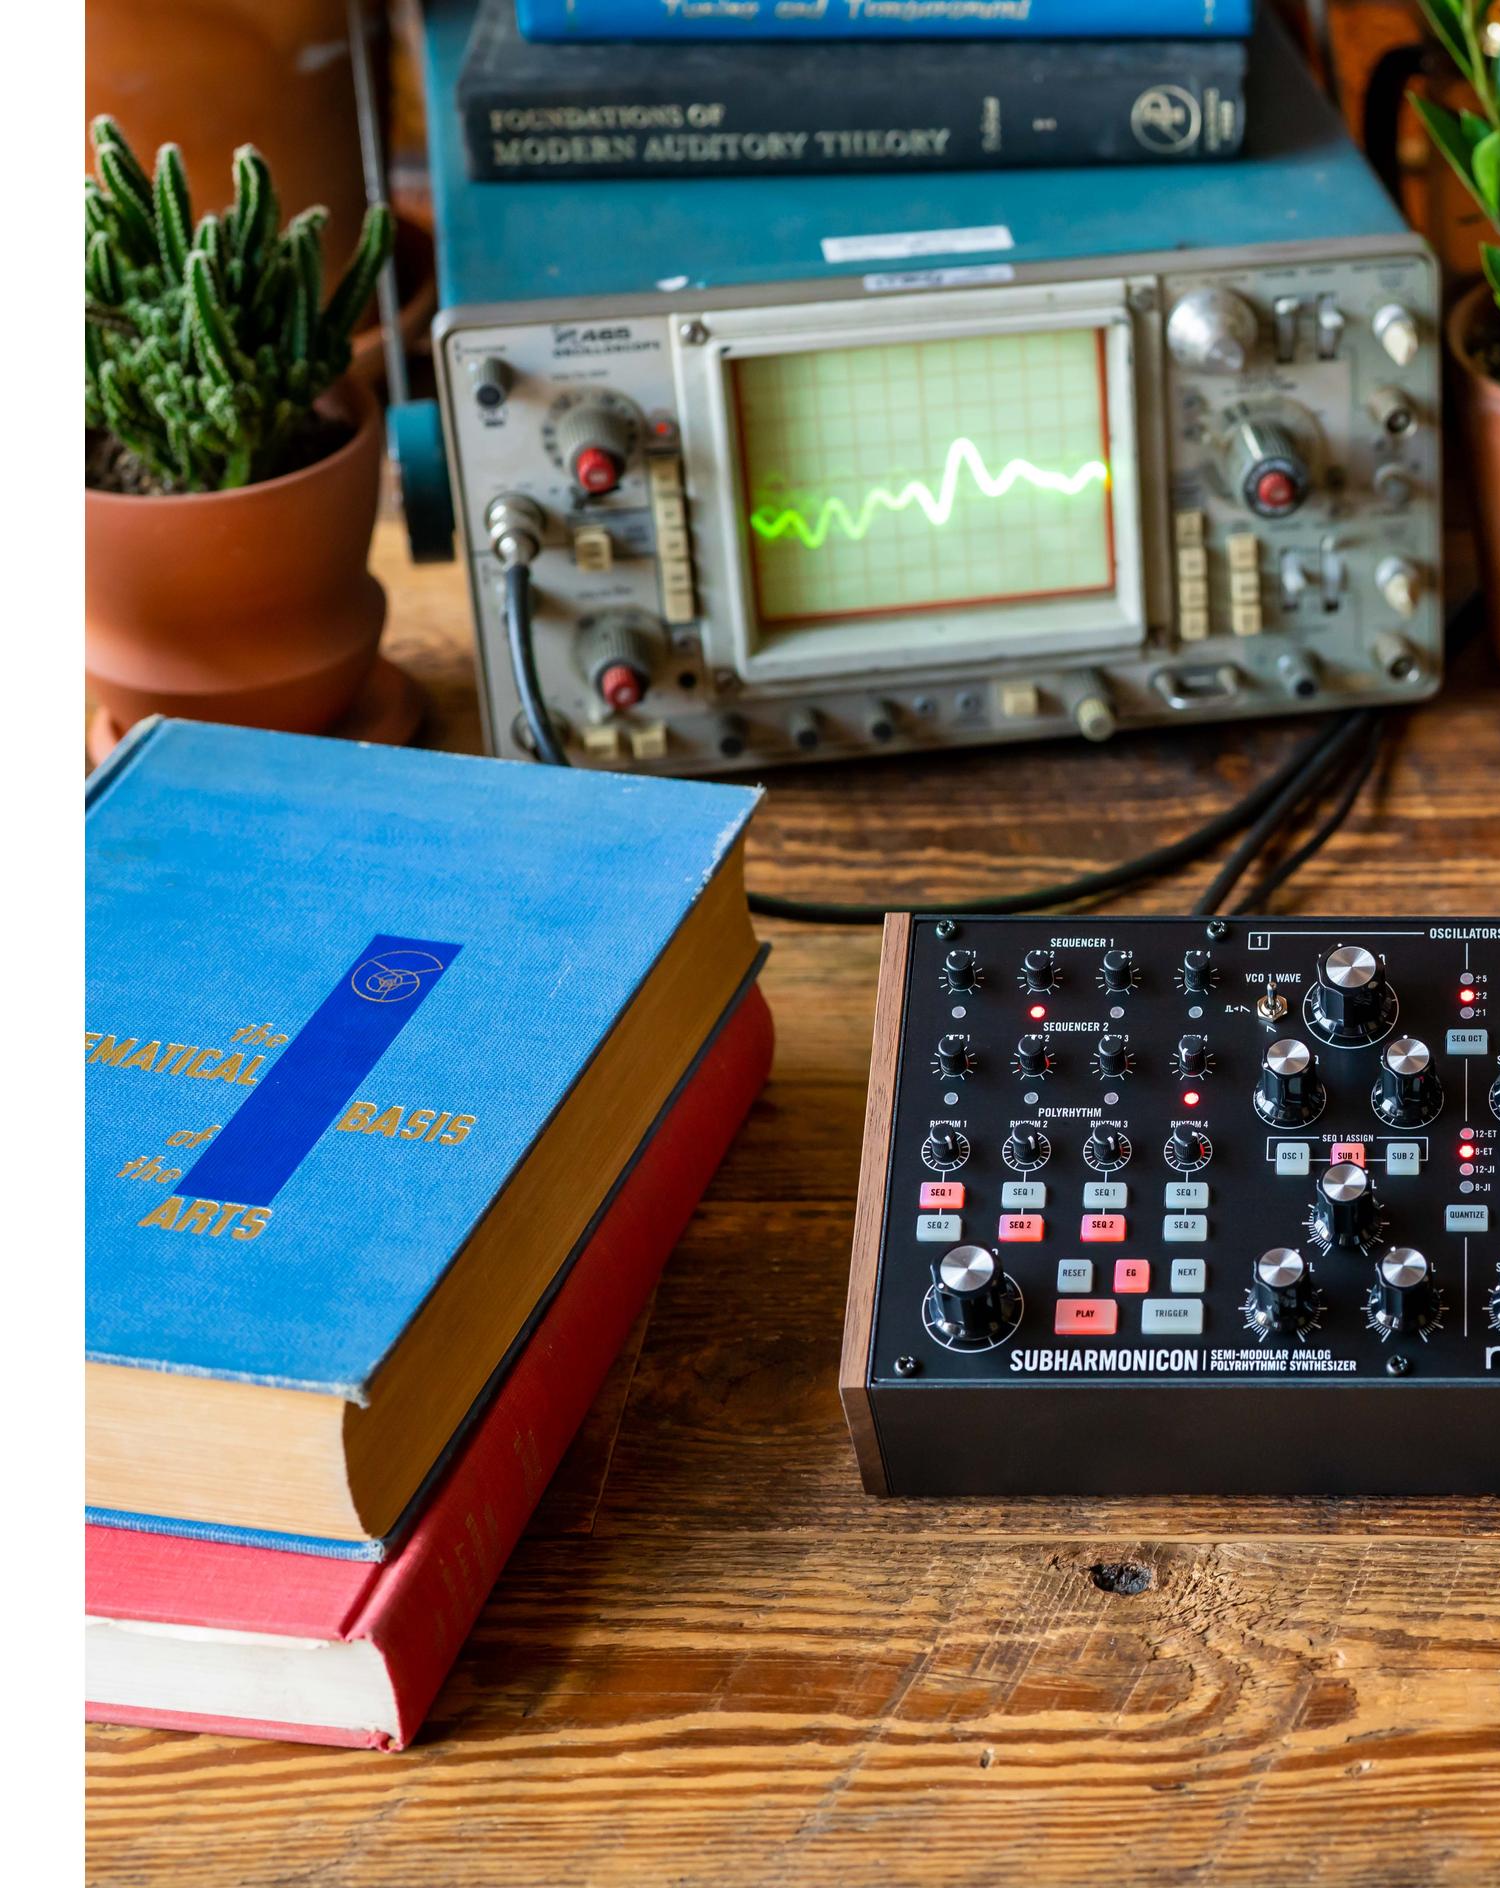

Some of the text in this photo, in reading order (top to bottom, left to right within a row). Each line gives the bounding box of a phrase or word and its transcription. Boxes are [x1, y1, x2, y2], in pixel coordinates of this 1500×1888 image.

[489, 103, 726, 132] FOUNDATIONS OF
[493, 128, 951, 166] MODERN AUDITORY THEORY
[1050, 938, 1114, 948] SEQUENCER 1
[1245, 973, 1301, 983] VCO 1 WAVE
[1043, 1022, 1109, 1032] SEQUENCER 2
[230, 1023, 290, 1049] the
[1452, 1035, 1482, 1043] SEQ OCT
[1038, 1108, 1102, 1118] POLYRHYTHM
[336, 1101, 476, 1146] BASIS
[166, 1125, 222, 1149] of
[1322, 1134, 1374, 1143] SEQ 1 ASSIGN
[1475, 1130, 1497, 1138] 12-ET
[1282, 1152, 1303, 1160] OSC 1
[1337, 1152, 1353, 1160] SUB
[1392, 1152, 1414, 1160] SUB 2
[1475, 1148, 1492, 1156] 8-ET
[116, 1155, 182, 1184] the
[1475, 1165, 1495, 1174] 12-JI
[1475, 1183, 1491, 1192] 8-JI
[930, 1188, 952, 1197] SEQ 1
[1012, 1188, 1034, 1197] SEQ 1
[1094, 1188, 1116, 1197] SEQ 1
[1176, 1188, 1198, 1197] SEQ 1
[137, 1196, 273, 1241] ARTS
[1450, 1211, 1485, 1219] QUANTIZE
[927, 1221, 949, 1230] SEQ 2
[1174, 1221, 1196, 1230] SEQ 2
[1062, 1269, 1086, 1278] RESET
[1126, 1269, 1137, 1277] EG
[1177, 1268, 1197, 1276] NEXT
[1075, 1309, 1095, 1318] PLAY
[1155, 1309, 1189, 1318] TRIGGER
[1210, 1349, 1331, 1360] SEMI-MODULAR ANALOG
[1010, 1350, 1198, 1371] SUBHARMONICON
[1210, 1360, 1356, 1372] POLYRHYTHMIC SYNTHESIZER
